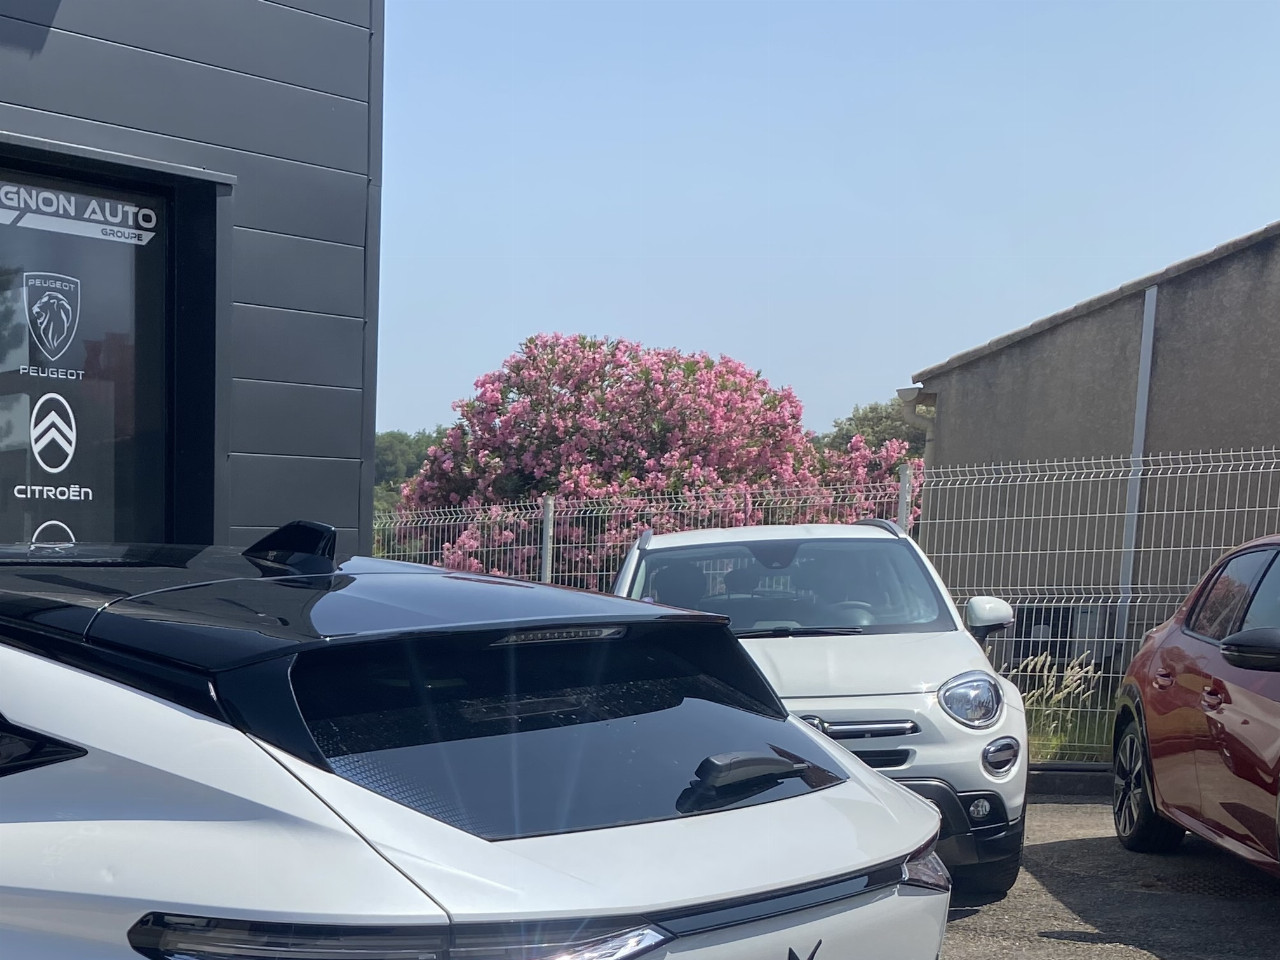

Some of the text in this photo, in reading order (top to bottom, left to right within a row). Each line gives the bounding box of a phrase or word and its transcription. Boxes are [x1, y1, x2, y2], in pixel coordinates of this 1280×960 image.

[83, 199, 157, 229] AUTO
[101, 228, 144, 242] GROUPE
[28, 278, 76, 292] PEUGEOT
[19, 365, 85, 381] PEUGEOT
[13, 484, 93, 500] CITROËN
